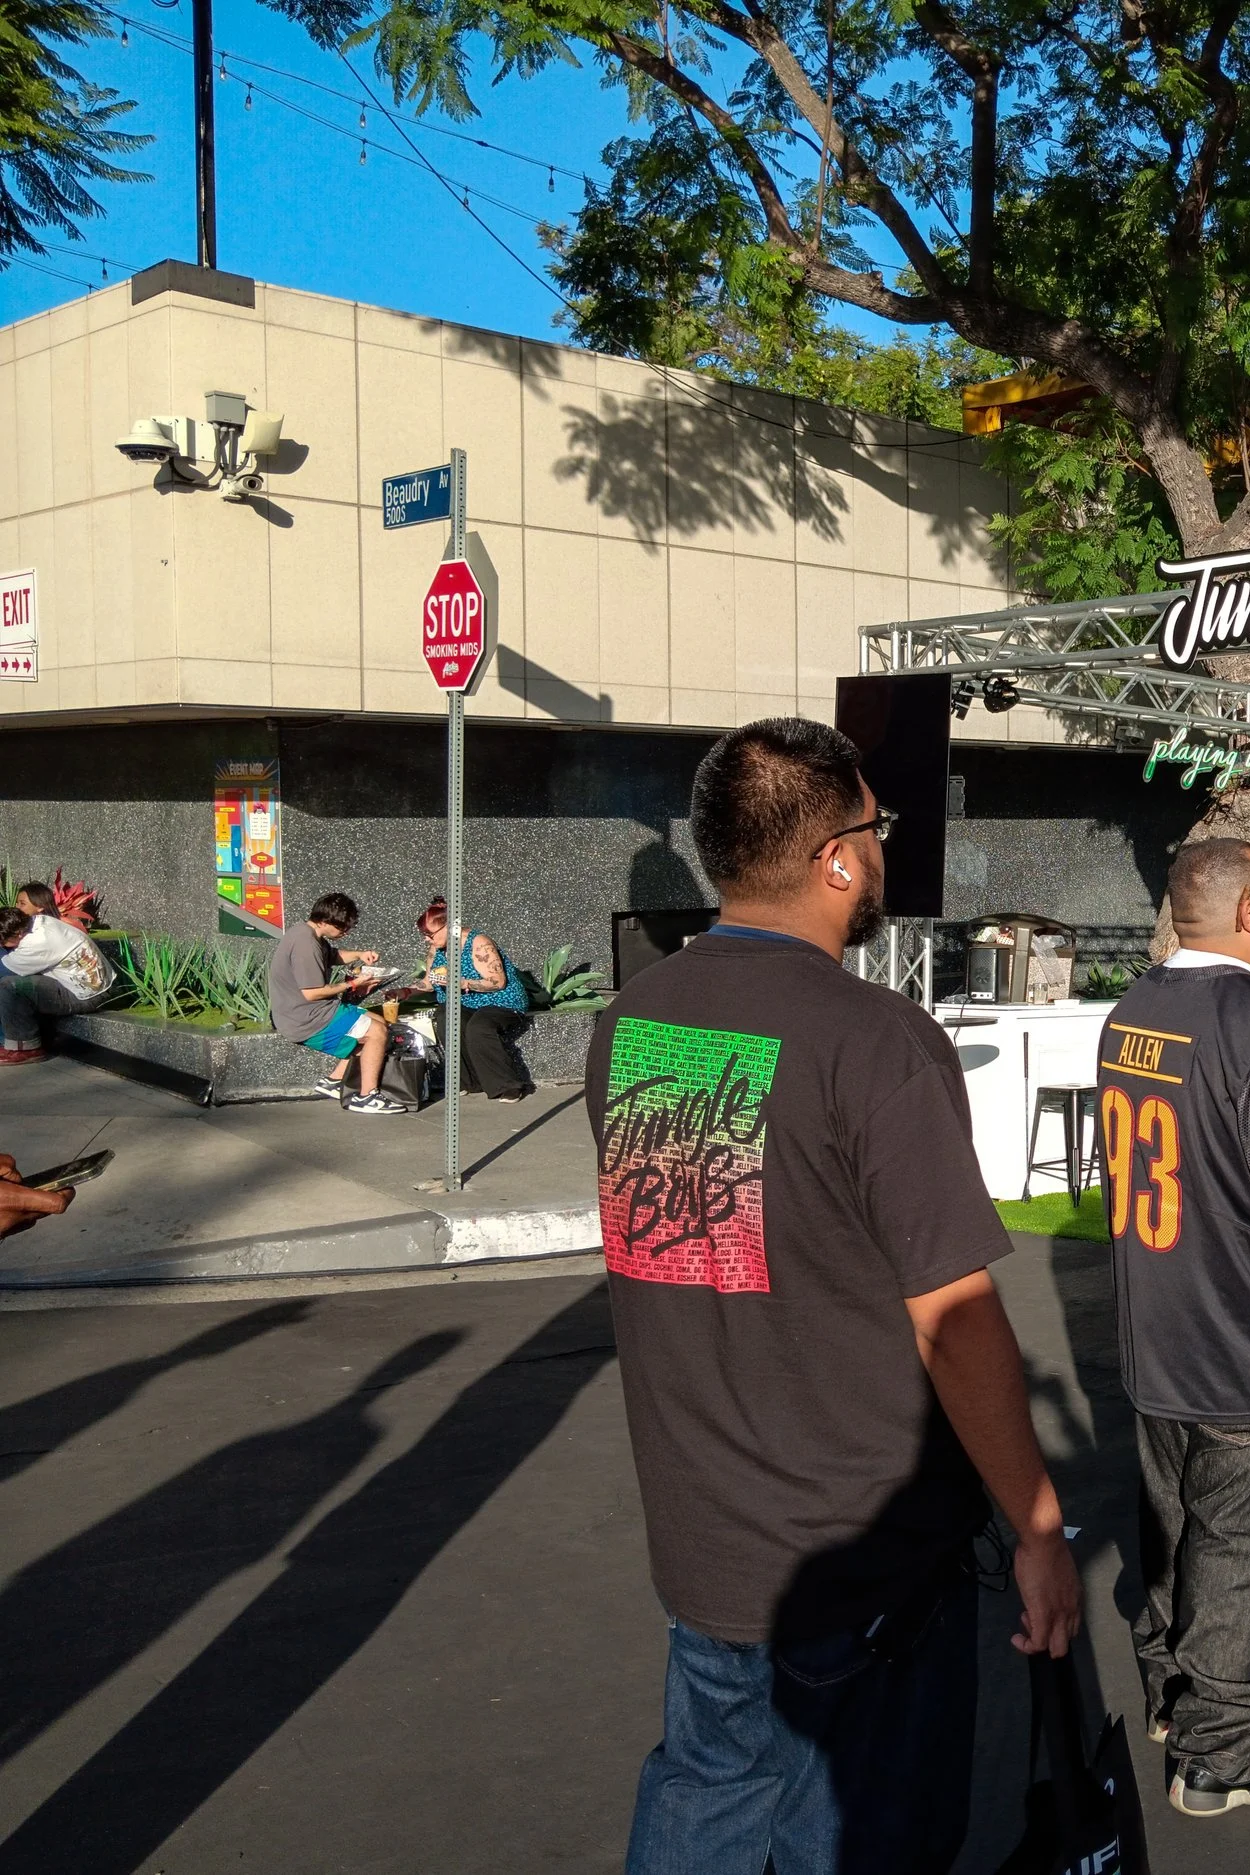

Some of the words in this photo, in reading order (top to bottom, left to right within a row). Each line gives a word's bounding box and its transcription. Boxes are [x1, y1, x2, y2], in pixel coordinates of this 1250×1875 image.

[385, 477, 430, 507] Beaudry
[439, 471, 449, 489] Av
[2, 587, 31, 628] EXIT
[426, 591, 480, 640] STOP
[425, 643, 459, 659] SMOKING
[460, 641, 479, 657] MIDS
[229, 762, 248, 776] EVENT
[249, 762, 264, 776] MAP
[1144, 726, 1243, 790] playing
[1117, 1033, 1165, 1072] ALLEN
[1102, 1085, 1183, 1253] 93
